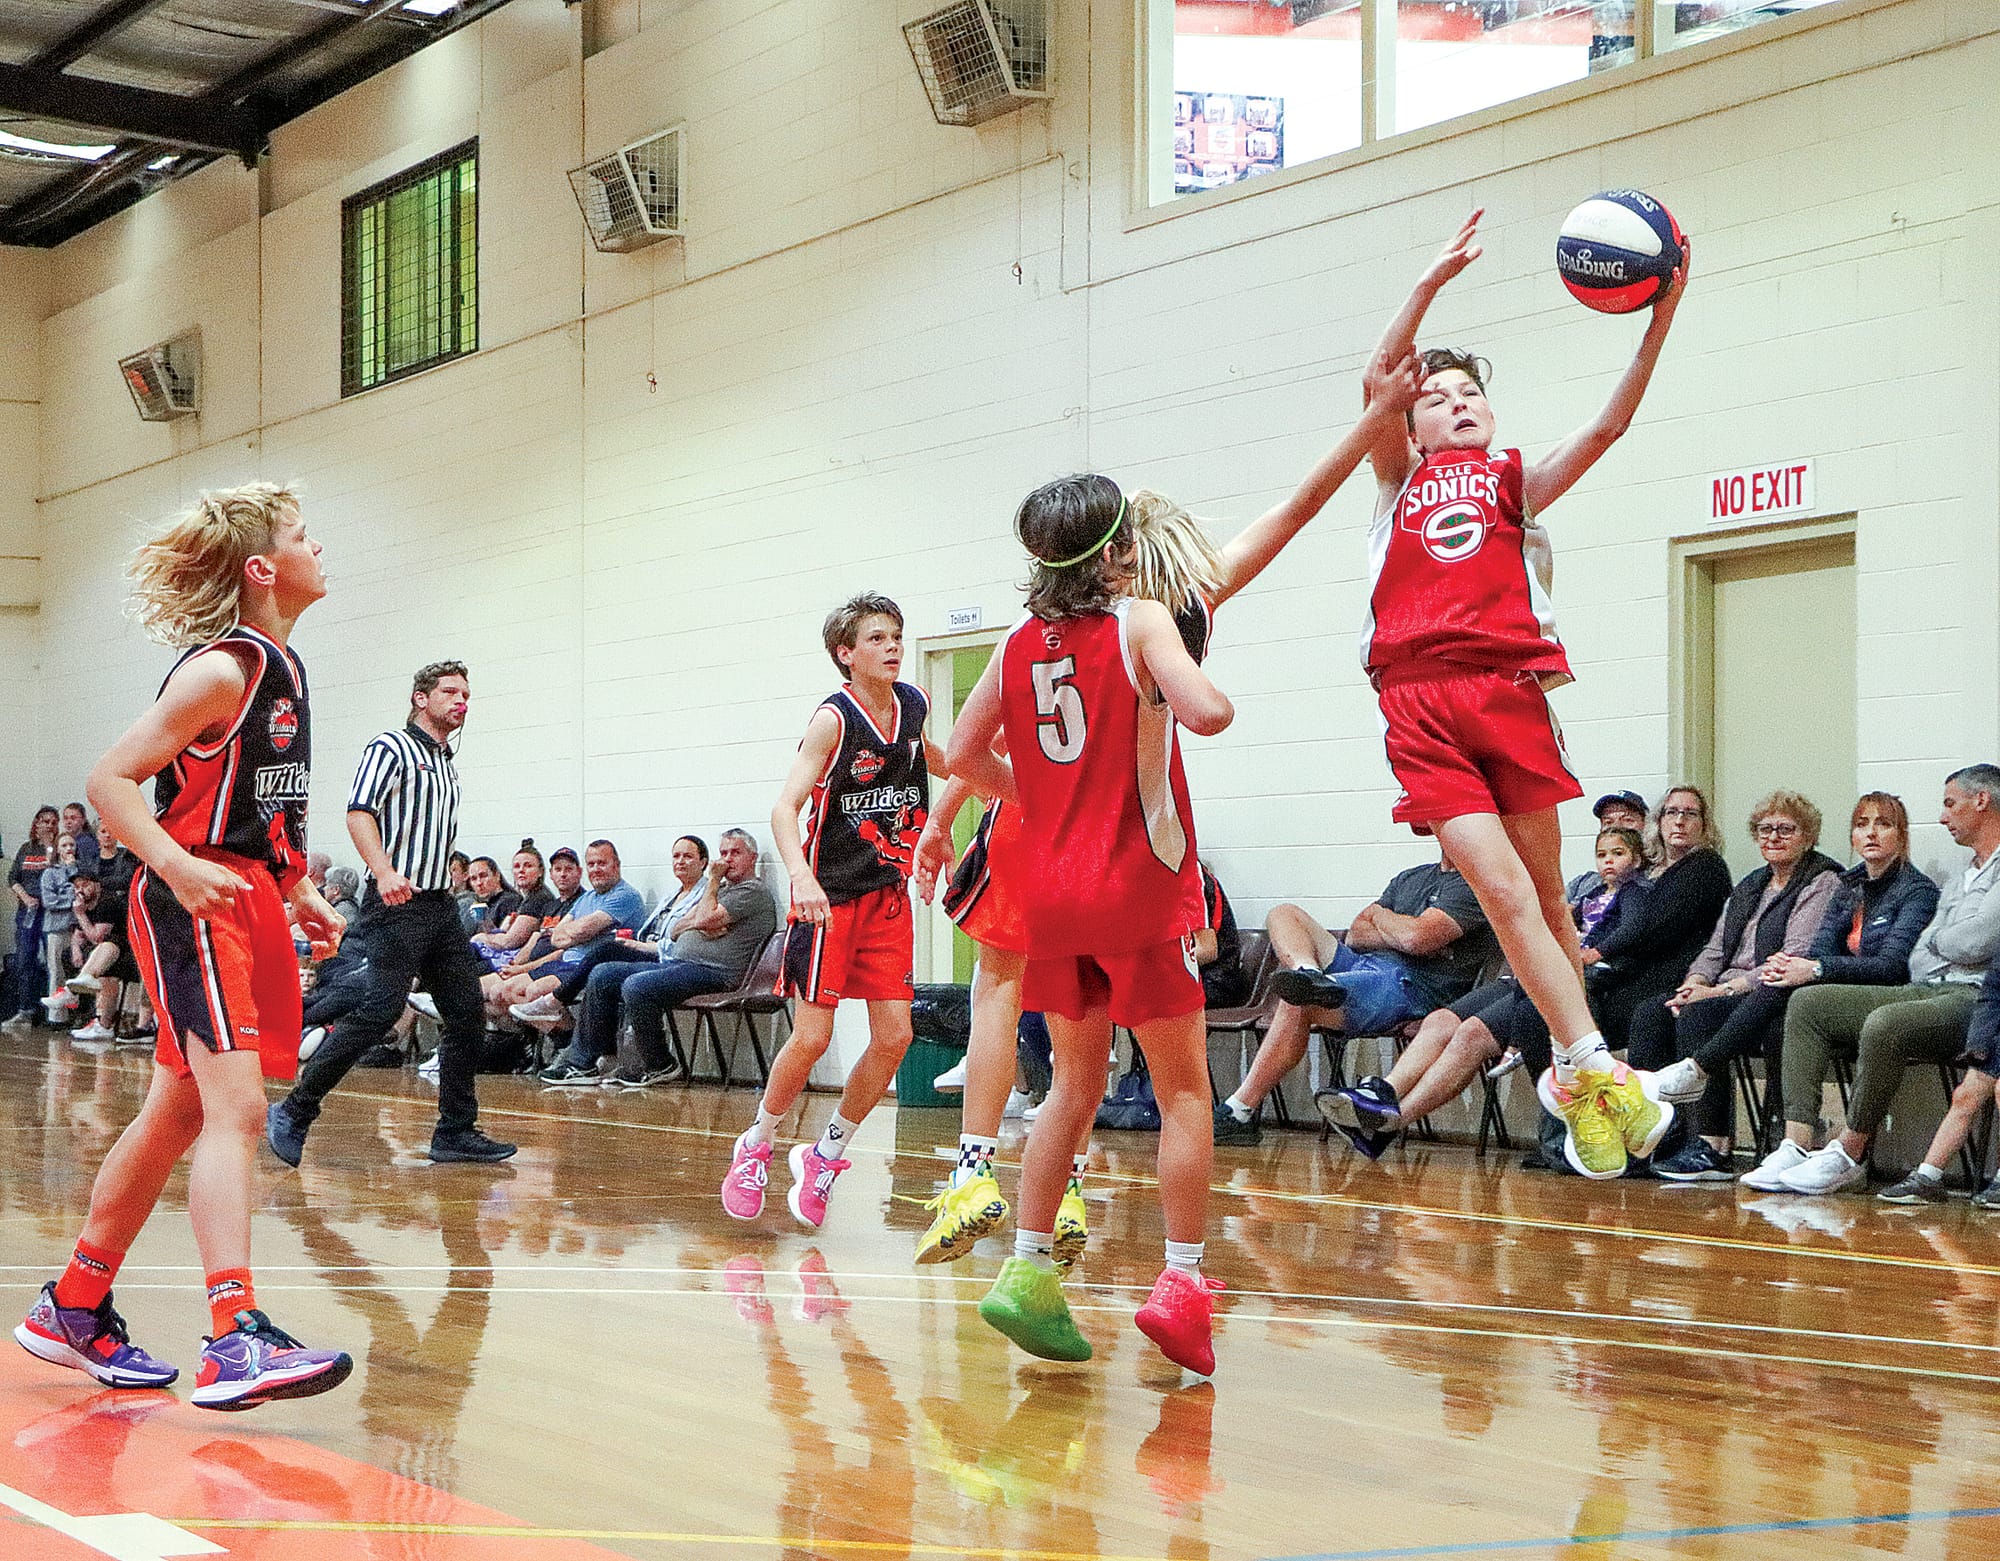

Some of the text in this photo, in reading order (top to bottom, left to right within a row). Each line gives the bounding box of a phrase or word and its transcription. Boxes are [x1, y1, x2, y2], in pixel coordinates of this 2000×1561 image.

[1434, 465, 1472, 479] SALE
[1712, 465, 1807, 518] NO EXIT
[1405, 473, 1499, 517] SONICS
[950, 613, 971, 625] Toilets
[1031, 655, 1088, 764] 5
